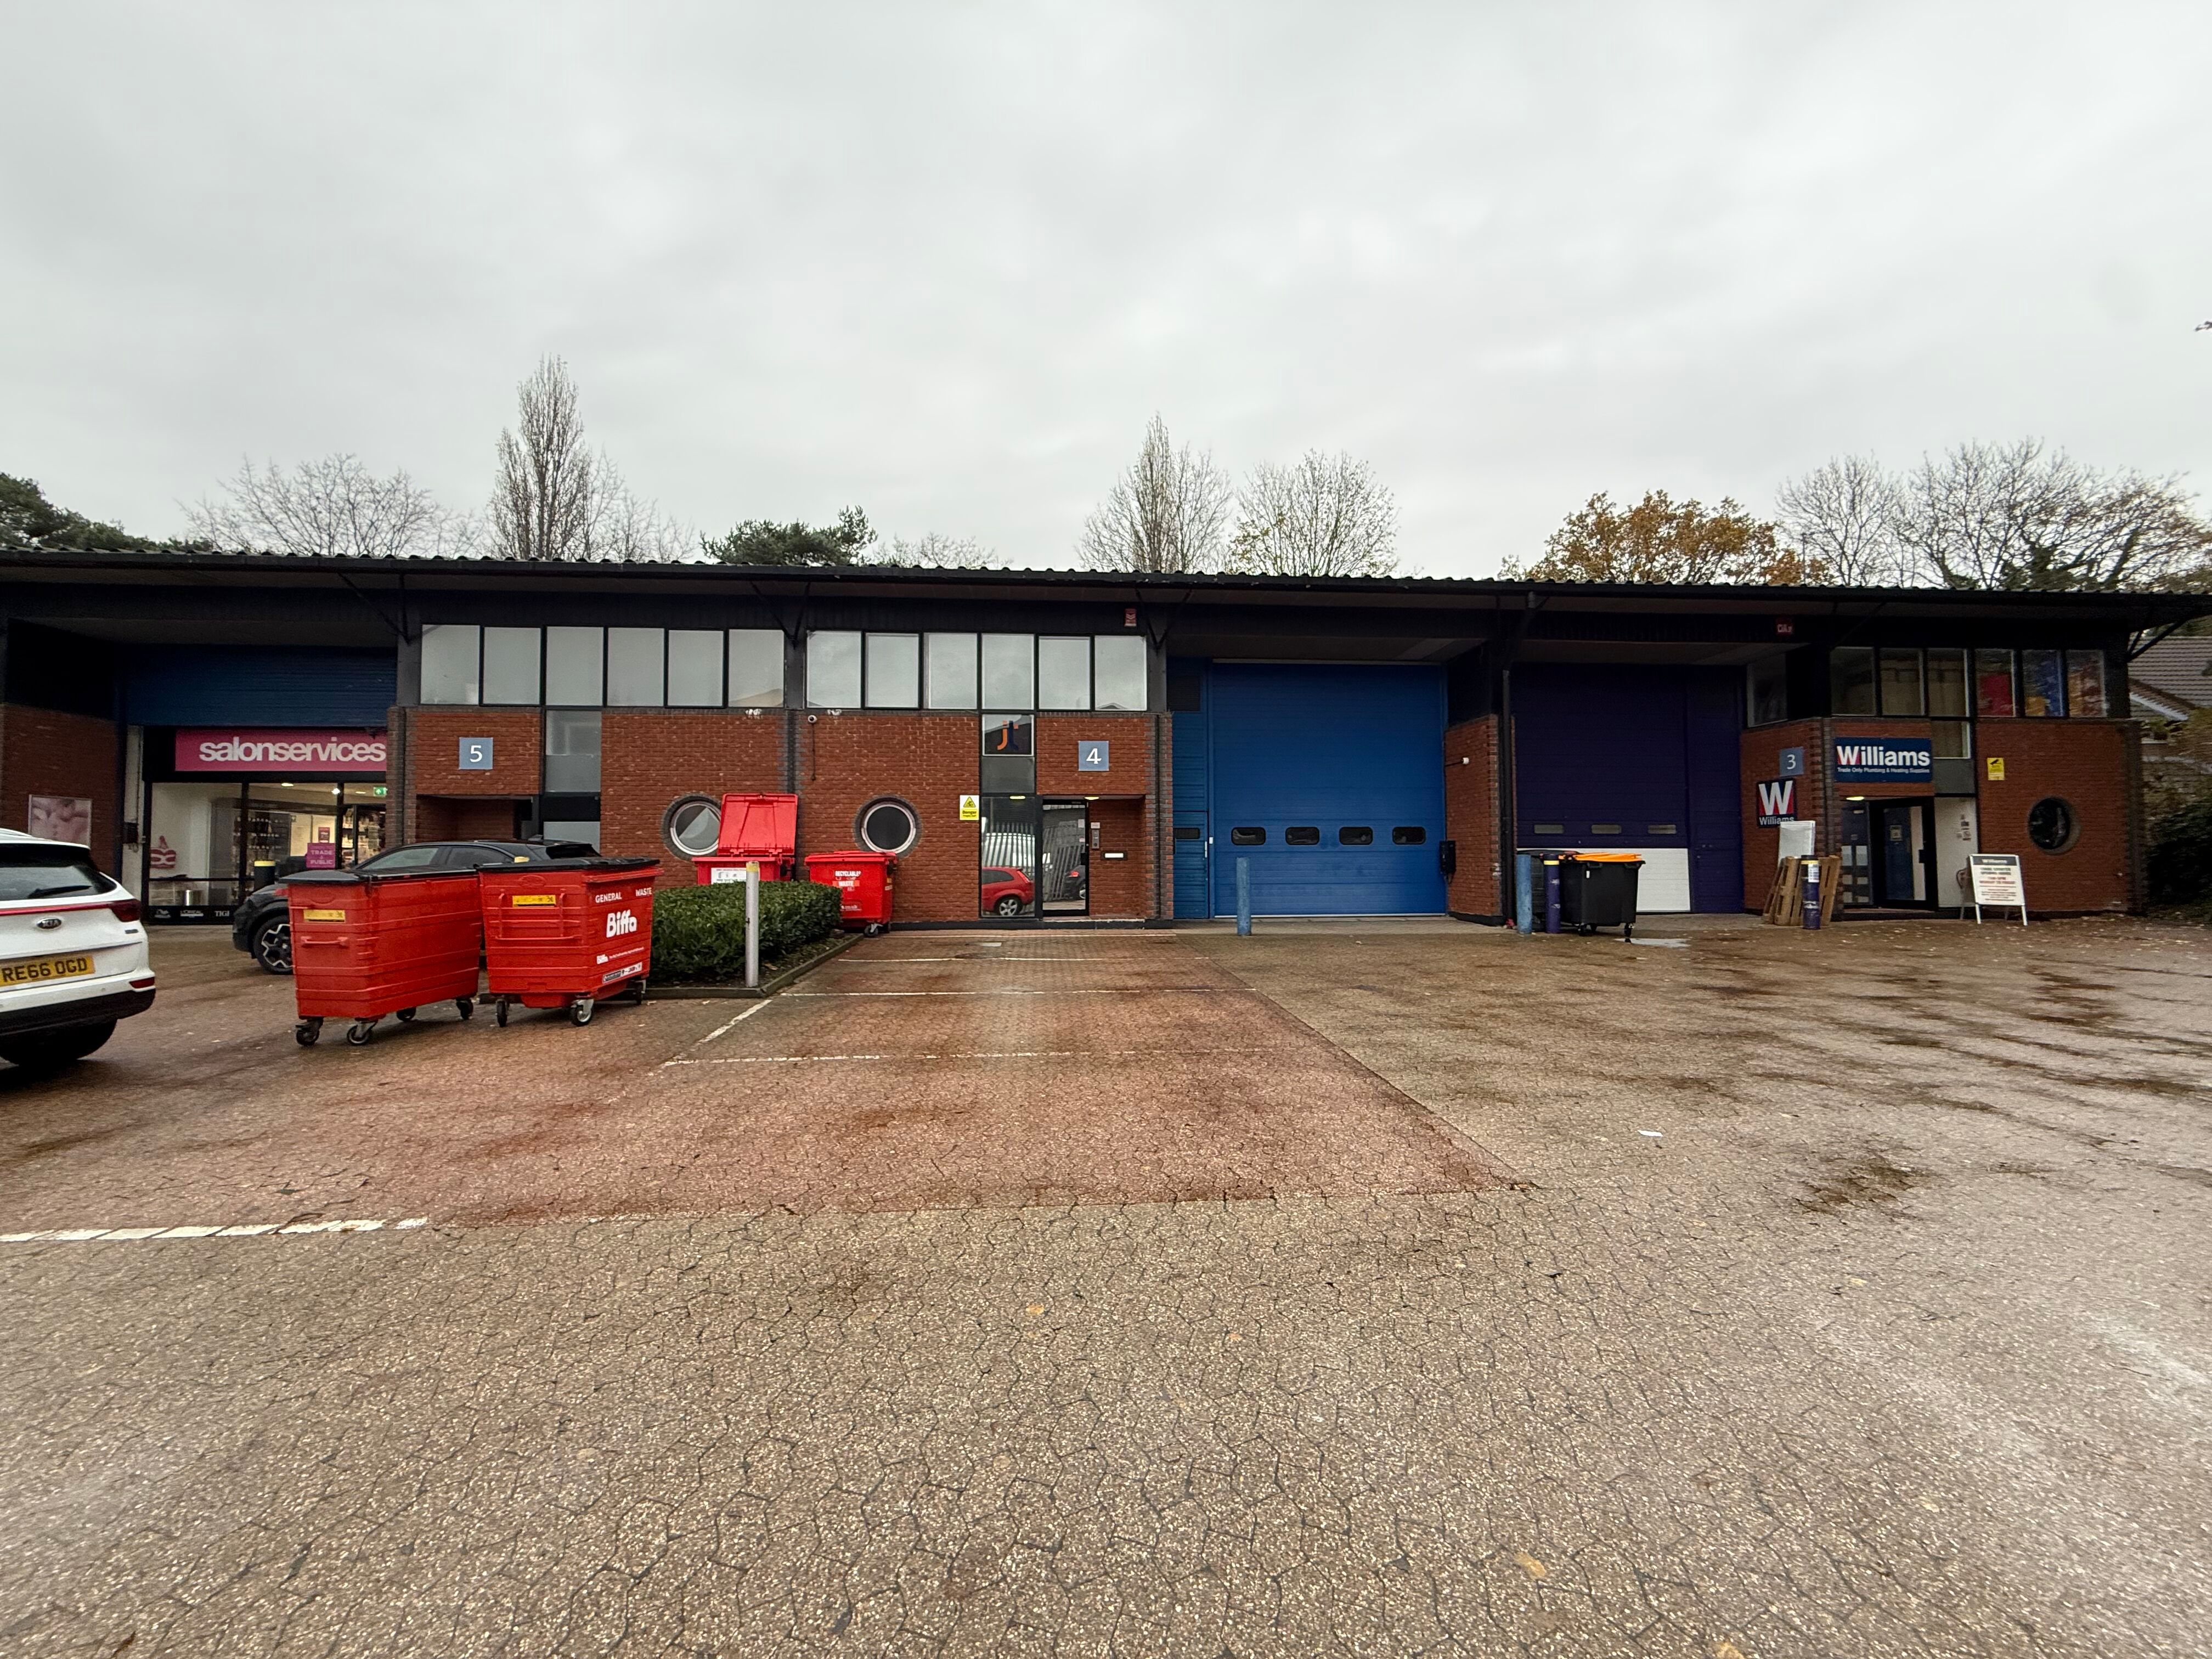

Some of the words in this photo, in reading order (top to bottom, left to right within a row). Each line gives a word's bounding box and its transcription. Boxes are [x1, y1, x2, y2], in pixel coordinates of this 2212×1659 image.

[199, 736, 386, 762] salonservices
[470, 745, 483, 763] 5
[1086, 748, 1102, 764] 4
[1837, 746, 1931, 766] Williams
[1786, 754, 1796, 770] 3
[1758, 780, 1793, 816] W
[1759, 816, 1795, 826] Williams
[595, 891, 622, 904] GENERAL
[635, 887, 652, 896] WASTE
[606, 909, 637, 938] Biffa
[1, 962, 52, 983] RE66
[54, 957, 88, 974] OGD
